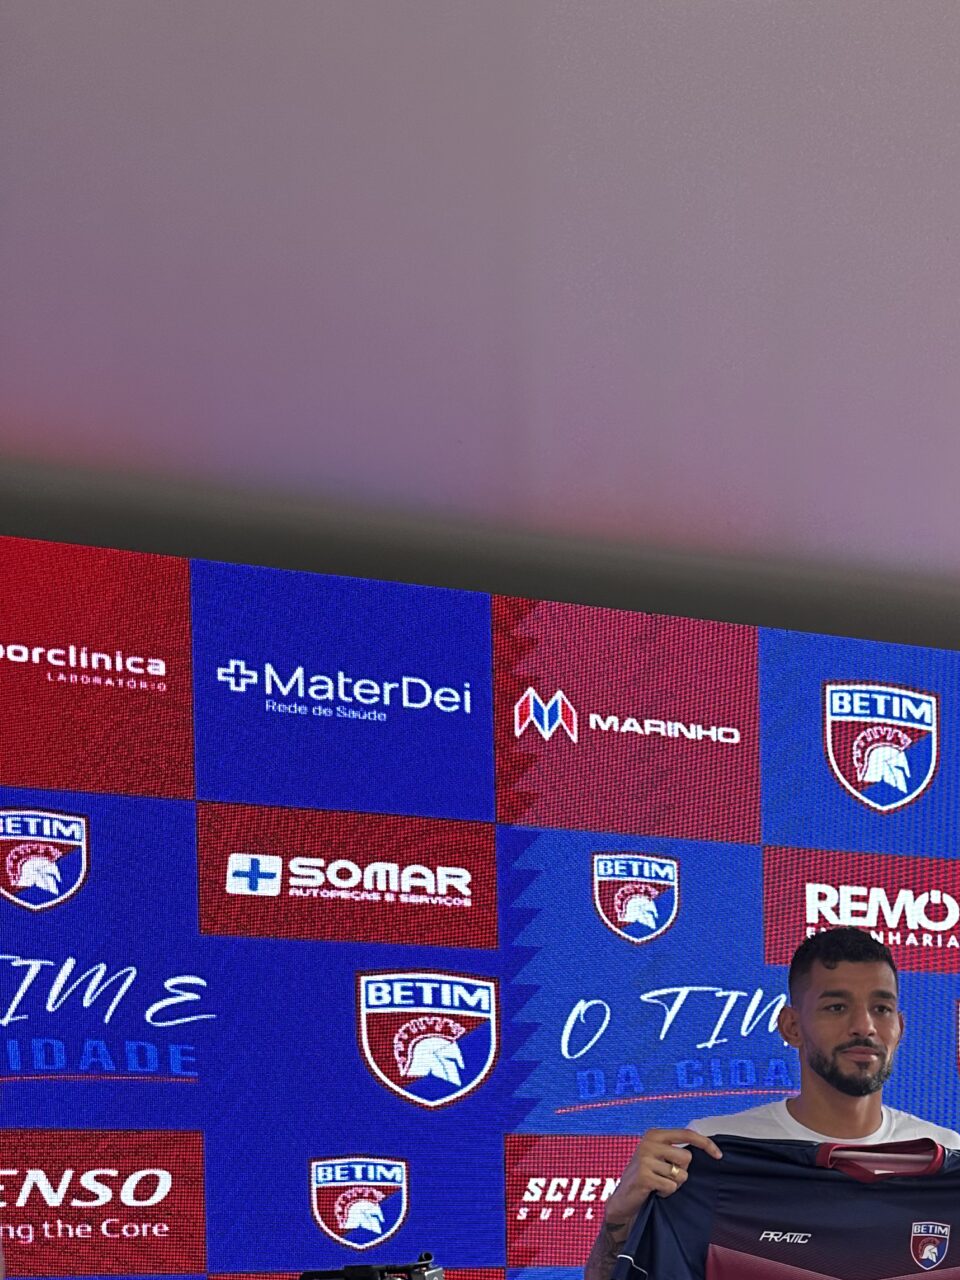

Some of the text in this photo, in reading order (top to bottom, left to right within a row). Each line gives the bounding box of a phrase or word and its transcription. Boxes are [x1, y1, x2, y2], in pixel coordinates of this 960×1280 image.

[0, 644, 166, 676] orclínica
[264, 662, 472, 714] MaterDei
[265, 699, 387, 722] Rede de Saúde
[831, 690, 932, 724] BETIM
[589, 712, 741, 744] MARINHO
[0, 816, 81, 840] ETIM
[288, 857, 472, 896] SOMAR
[598, 860, 674, 880] BETIM
[289, 888, 381, 901] AUTOPEÇAS
[386, 892, 395, 902] E
[806, 883, 960, 931] REMO
[806, 926, 960, 948] ENHARIA
[0, 956, 217, 1027] IME
[367, 981, 491, 1011] BETIM
[561, 985, 789, 1059] O TIM
[7, 1038, 199, 1076] IDADE
[576, 1058, 793, 1099] DA CIDA
[316, 1162, 402, 1183] BETIM
[522, 1178, 621, 1202] SCIEN
[516, 1207, 595, 1220] SUPL
[0, 1218, 170, 1244] ng the Core
[759, 1230, 812, 1244] PRATIC
[913, 1224, 949, 1236] BETIM
